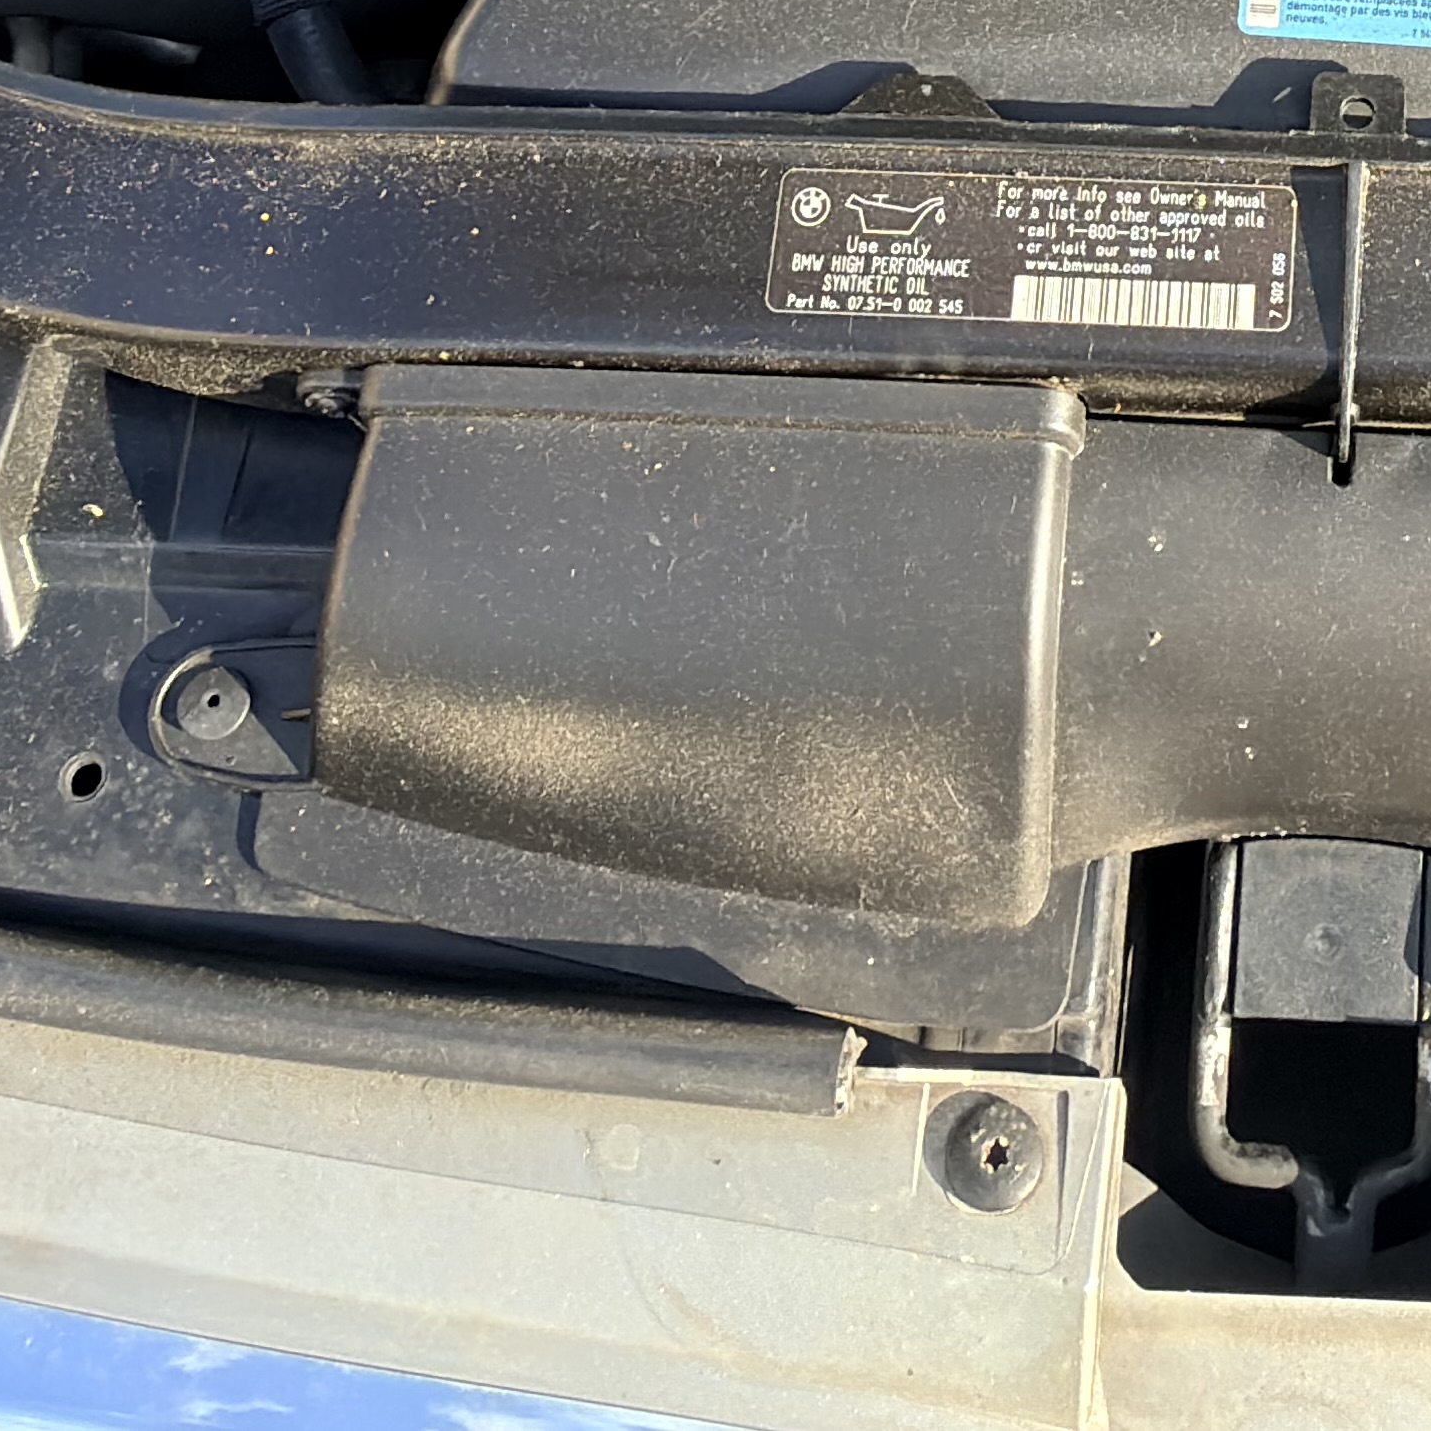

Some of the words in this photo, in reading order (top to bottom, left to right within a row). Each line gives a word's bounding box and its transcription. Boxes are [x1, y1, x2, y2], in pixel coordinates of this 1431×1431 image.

[1350, 6, 1369, 16] par
[1372, 6, 1390, 16] des
[1394, 9, 1408, 18] vis
[998, 184, 1021, 199] For
[1032, 187, 1068, 201] more
[1116, 192, 1141, 205] see
[1150, 189, 1206, 208] Owner's
[1214, 191, 1266, 209] Manual
[997, 200, 1020, 218] For
[1031, 207, 1039, 219] a
[1049, 204, 1075, 221] list
[1085, 206, 1101, 221] of
[1110, 204, 1150, 223] other
[1159, 210, 1227, 228] approved
[1235, 211, 1265, 228] oils
[1027, 225, 1057, 238] call
[1067, 225, 1201, 242] 1-800-831-1117
[846, 235, 879, 254] Use
[891, 238, 931, 258] only
[1052, 241, 1087, 256] visit
[1095, 245, 1119, 257] our
[1129, 243, 1157, 259] web
[1166, 245, 1195, 260] site
[1204, 246, 1220, 260] at
[792, 253, 824, 272] BMW
[831, 255, 864, 274] HIGH
[872, 256, 971, 278] PERFORMANCE
[1025, 257, 1152, 274] www.bmwusa.com
[822, 276, 899, 294] SYNTHETIC
[907, 277, 930, 295] OIL
[786, 293, 814, 308] Part
[820, 296, 840, 311] No.
[909, 298, 932, 313] 002
[939, 299, 963, 314] 545
[1269, 309, 1283, 318] 7
